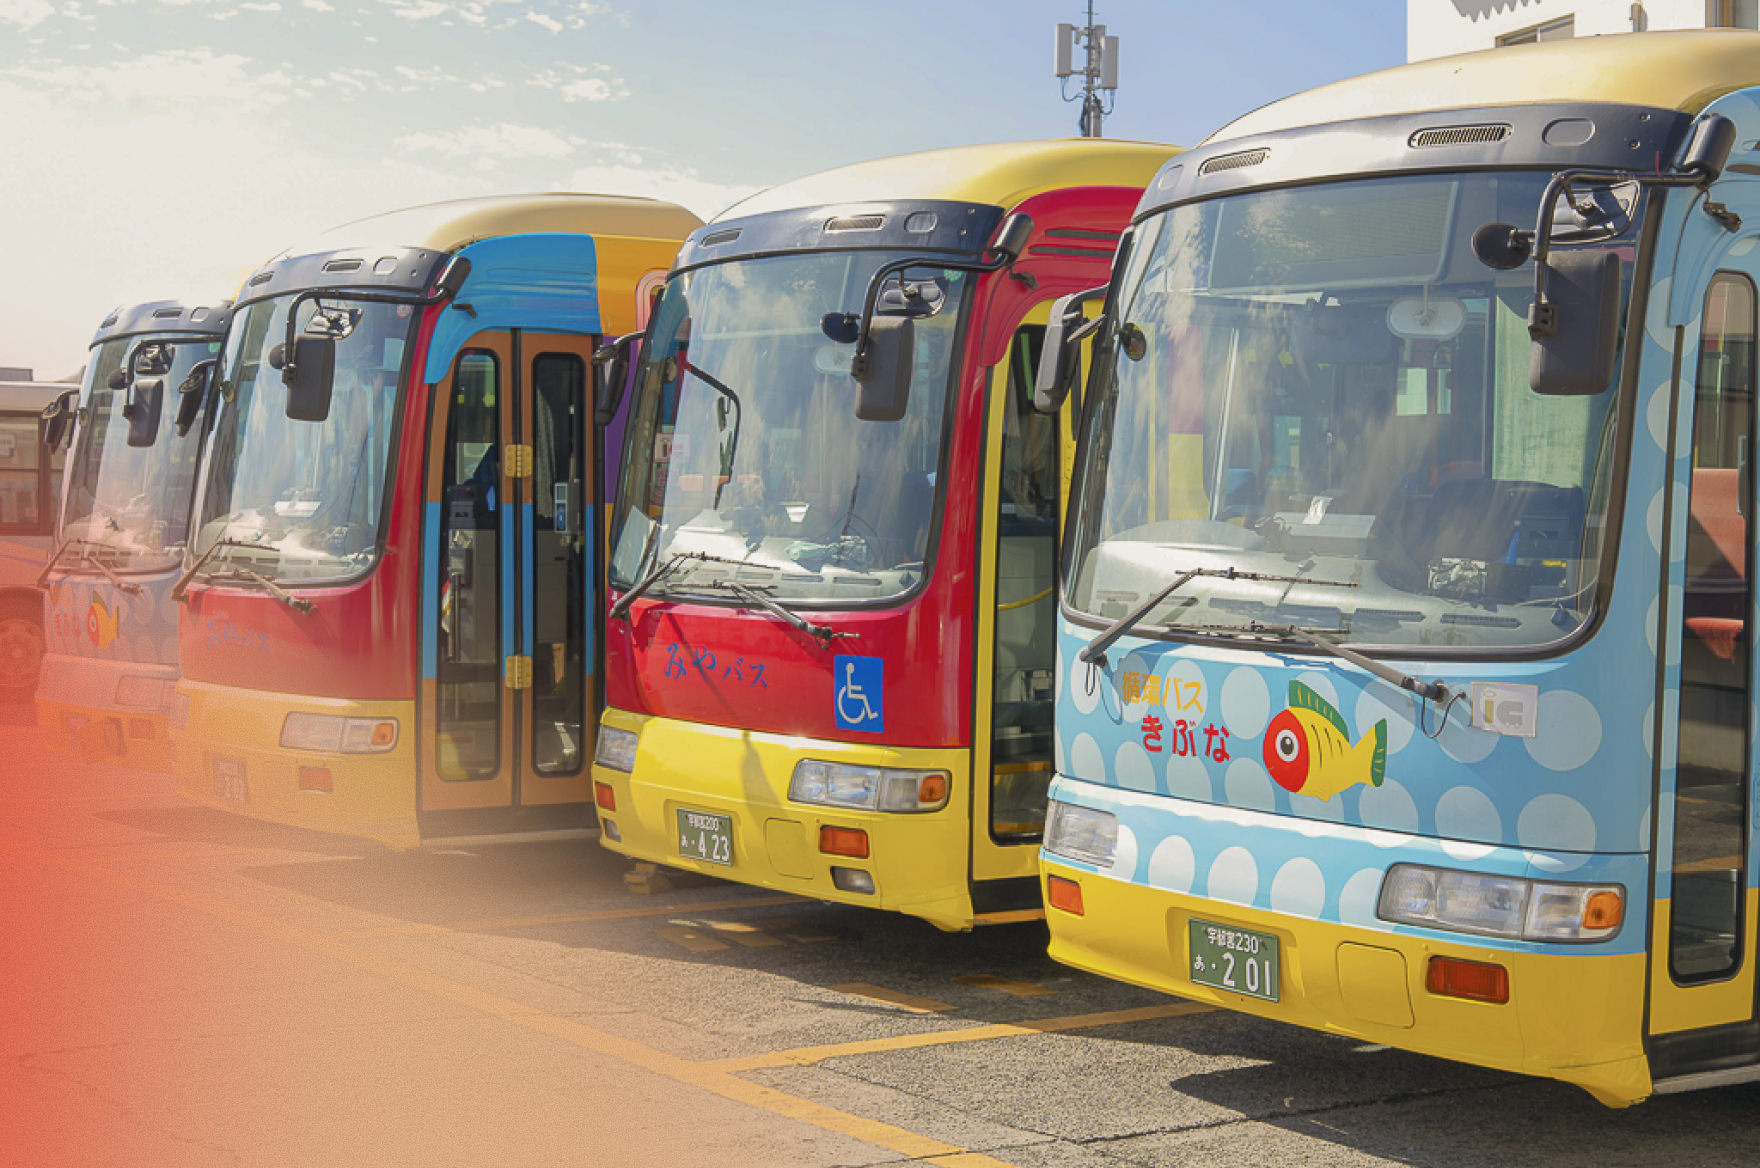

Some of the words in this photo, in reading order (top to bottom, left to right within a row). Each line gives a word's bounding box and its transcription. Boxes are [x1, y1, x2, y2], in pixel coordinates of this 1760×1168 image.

[664, 642, 769, 690] みやバス
[1122, 669, 1204, 714] 循環バス
[1140, 714, 1231, 763] きぶな
[1207, 927, 1259, 954] 宇都宮230
